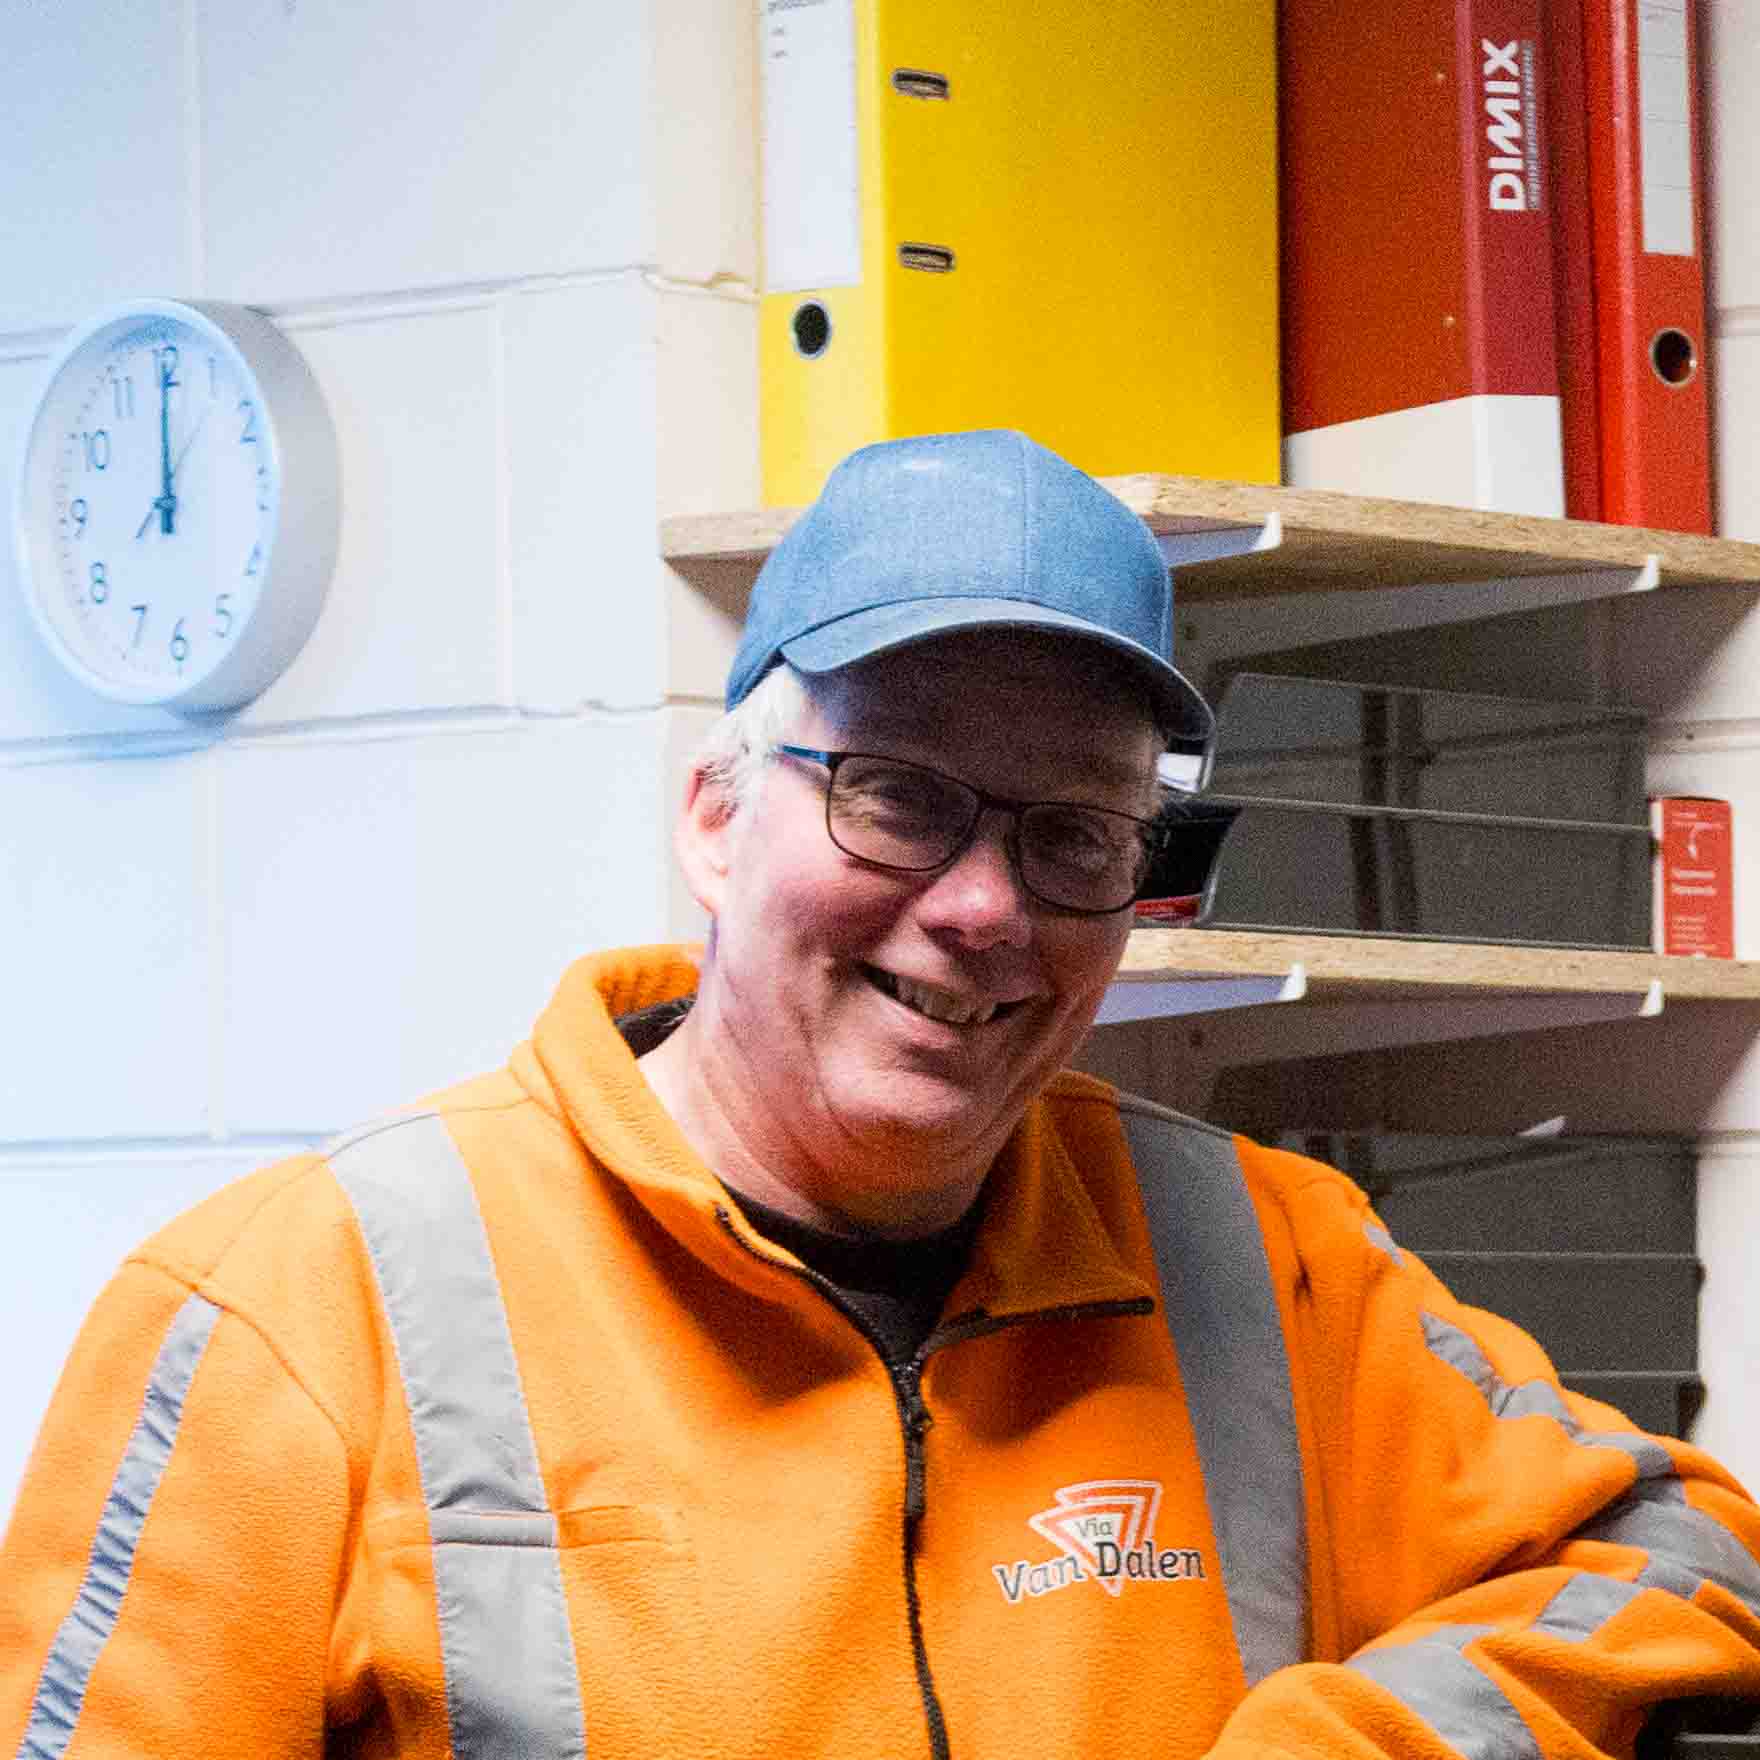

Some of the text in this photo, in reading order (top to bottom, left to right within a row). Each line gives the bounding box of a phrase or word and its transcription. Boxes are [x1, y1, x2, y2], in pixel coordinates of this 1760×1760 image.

[1482, 38, 1526, 211] DIMIX
[110, 374, 134, 418] 11
[239, 400, 257, 443] 2
[82, 430, 110, 471] 10
[71, 498, 87, 538] 9
[90, 562, 107, 604] 8
[131, 604, 147, 648] 7
[215, 593, 233, 638] 5
[171, 617, 188, 662] 6
[1076, 1518, 1113, 1537] Via
[996, 1540, 1206, 1601] Van Dalen
